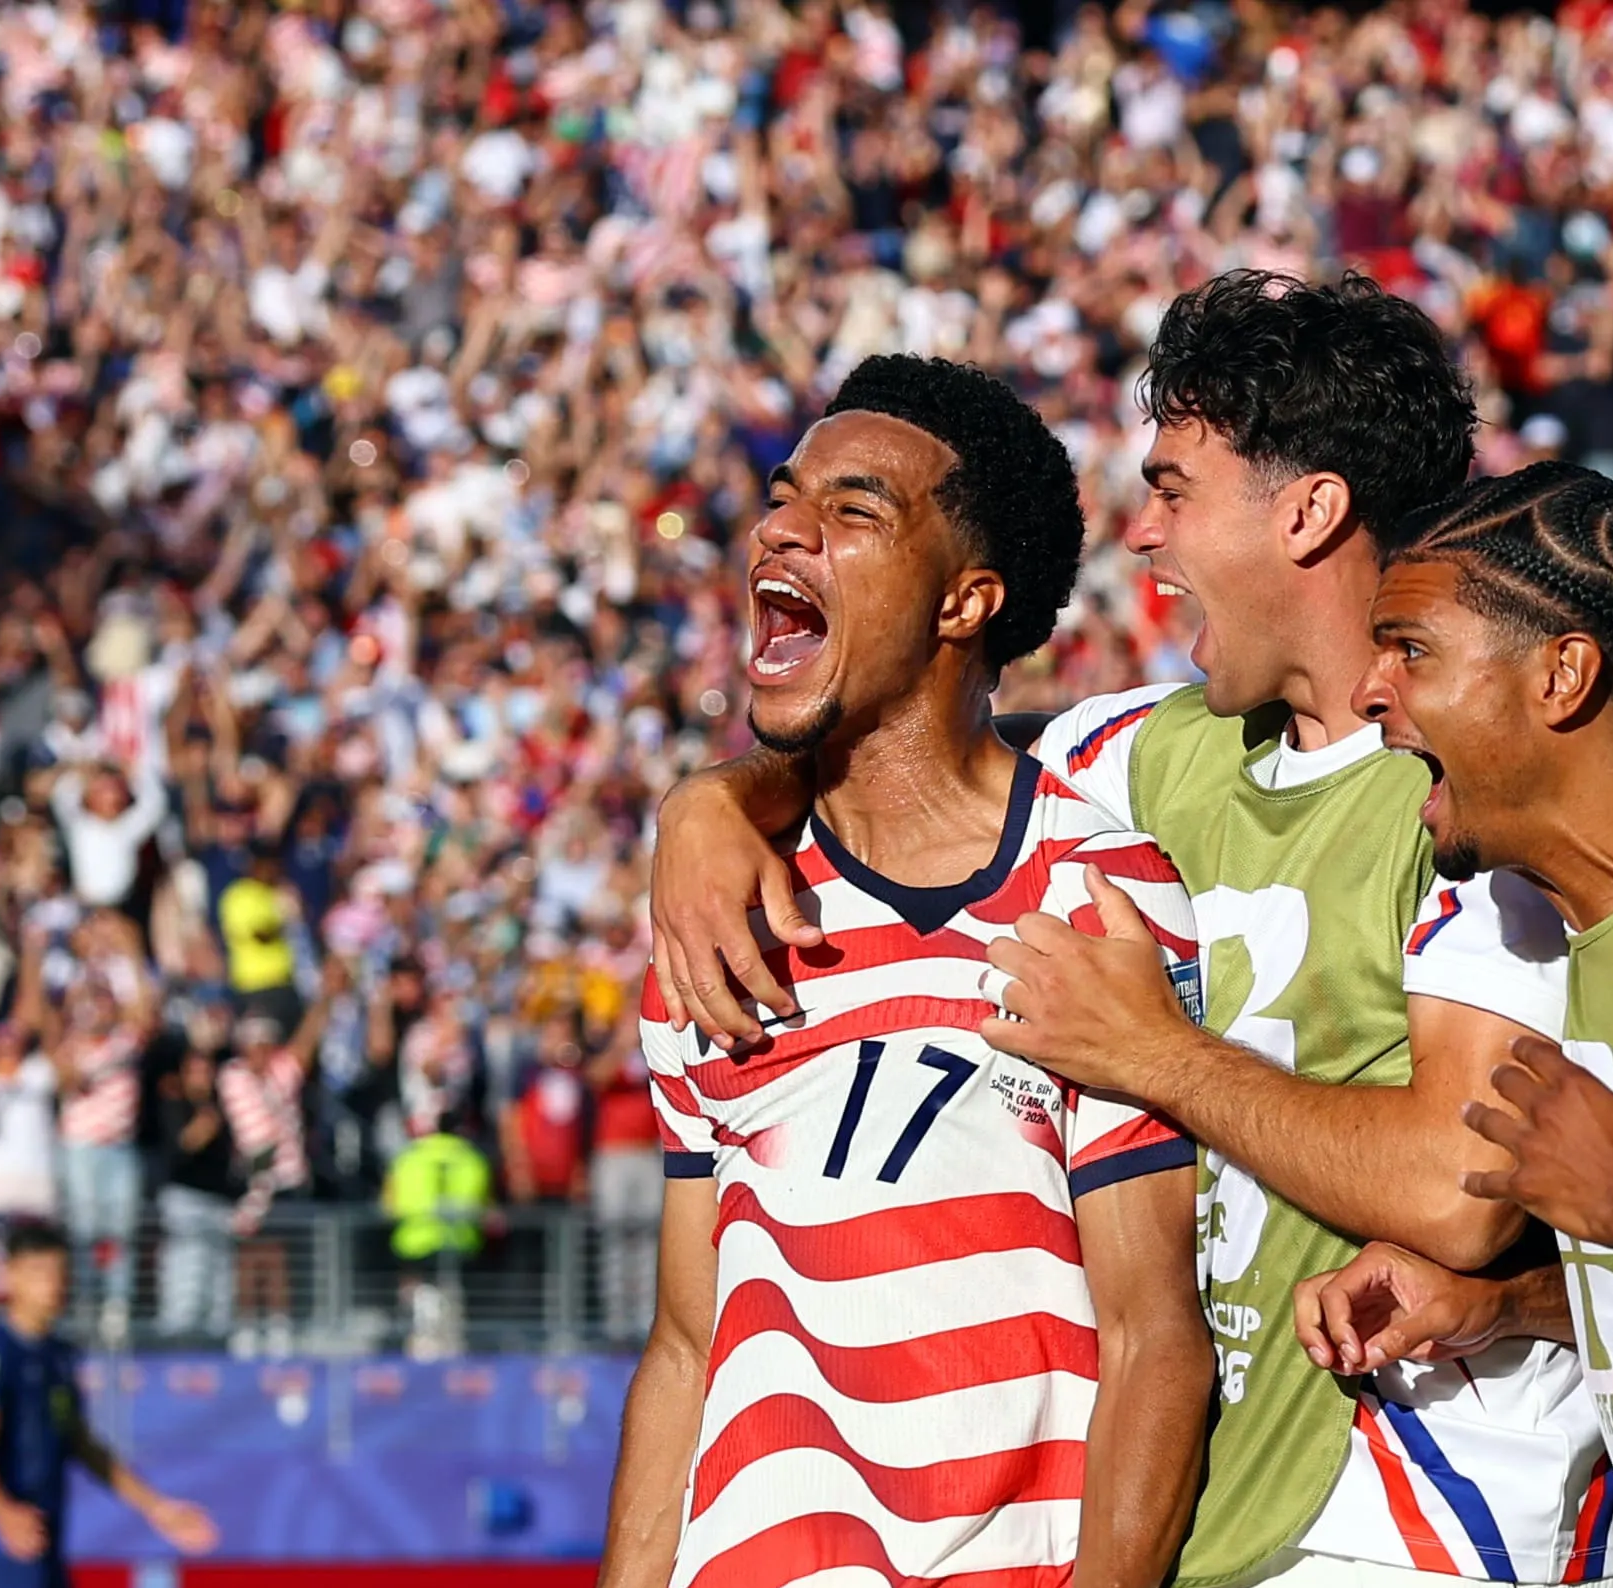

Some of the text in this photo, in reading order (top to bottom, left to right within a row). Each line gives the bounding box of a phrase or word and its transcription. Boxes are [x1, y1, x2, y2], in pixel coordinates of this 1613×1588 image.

[990, 1079, 1014, 1101] SANTA
[1000, 1073, 1016, 1088] USA
[1036, 1083, 1054, 1096] BIH
[822, 1039, 980, 1184] 17
[1006, 1103, 1023, 1118] JULY
[1211, 1302, 1261, 1341] CUP
